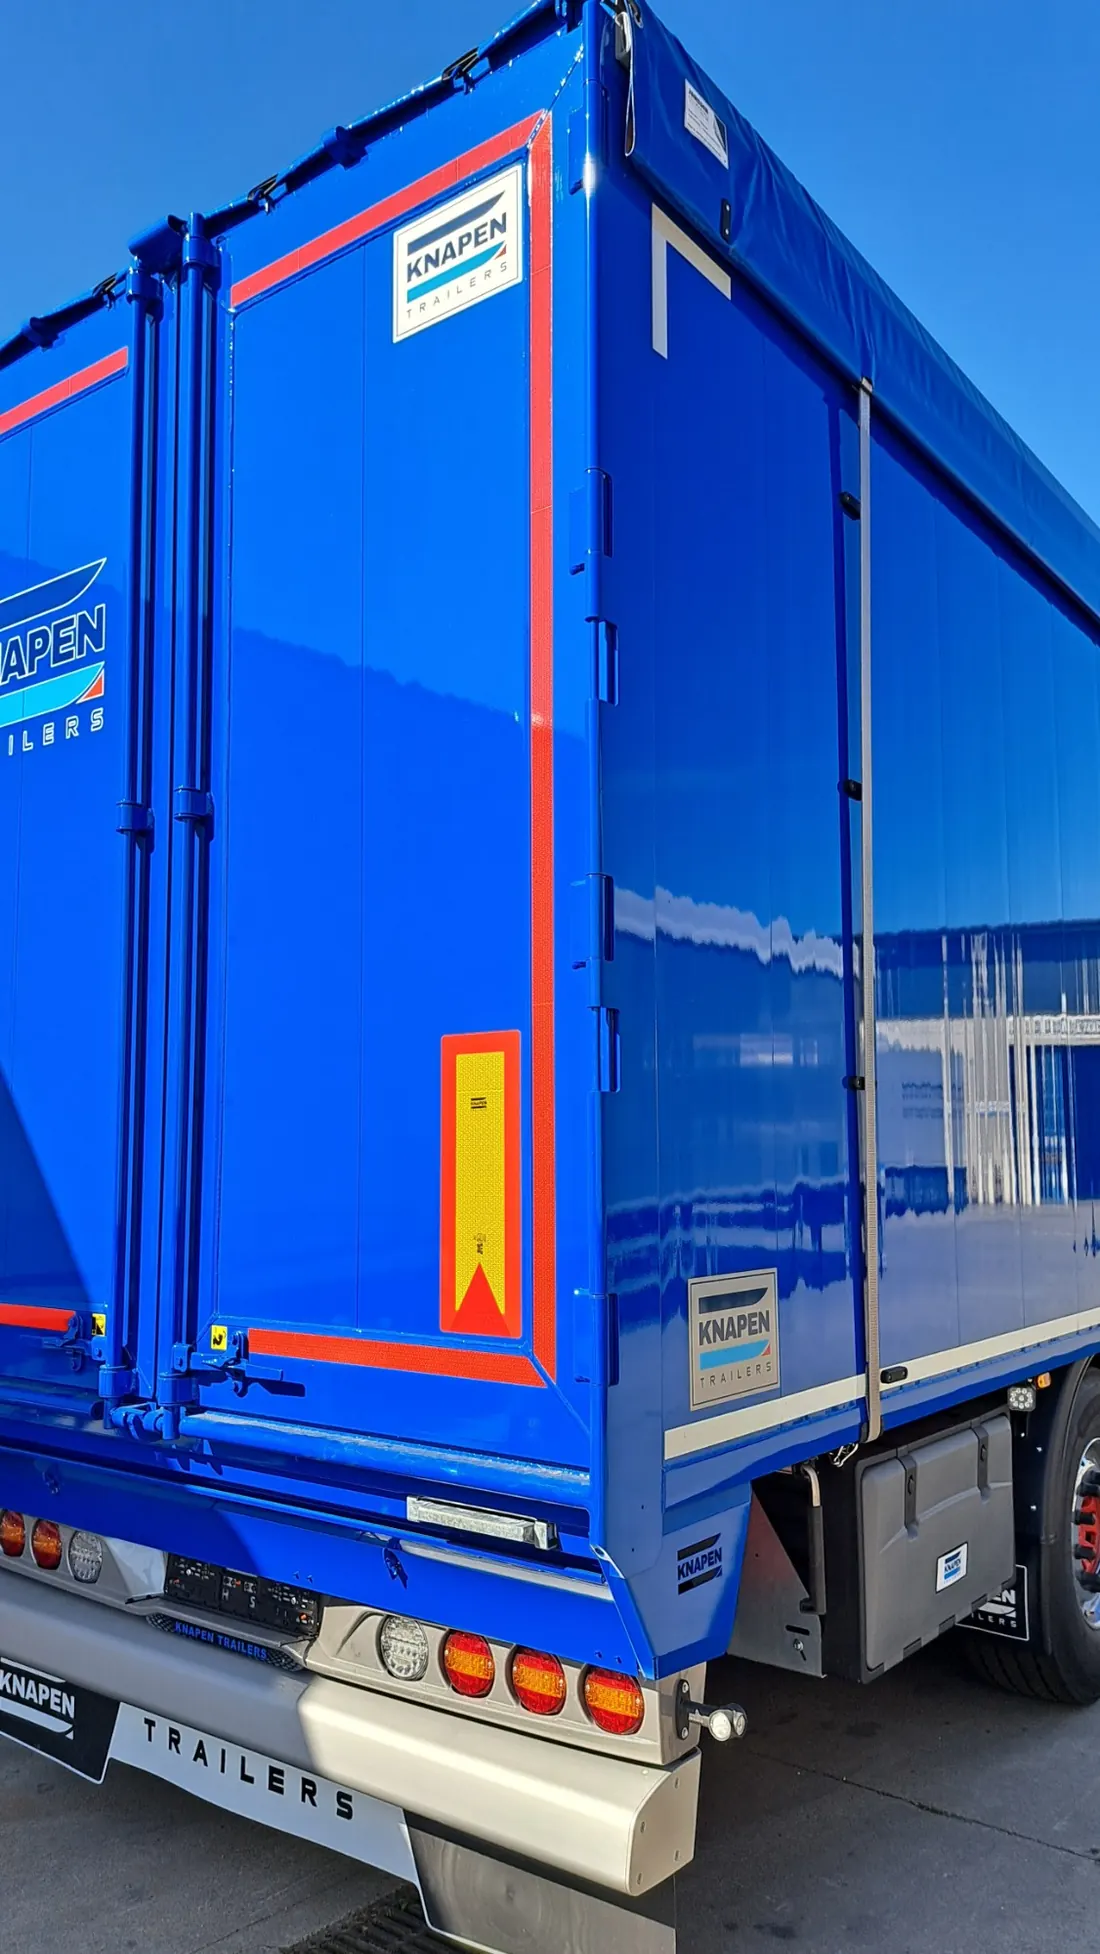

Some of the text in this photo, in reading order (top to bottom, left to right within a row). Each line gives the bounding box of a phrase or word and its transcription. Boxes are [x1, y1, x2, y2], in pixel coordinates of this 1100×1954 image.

[406, 211, 507, 283] KNAPEN
[405, 261, 507, 319] TRAILERS
[0, 603, 106, 686] APEN
[699, 1310, 770, 1346] KNAPEN
[700, 1361, 772, 1389] TRAILERS
[677, 1546, 722, 1580] KNAPEN
[174, 1620, 267, 1661] KNAPEN TRAILERS
[0, 1668, 75, 1720] KNAPEN
[143, 1717, 354, 1821] TRAILERS
